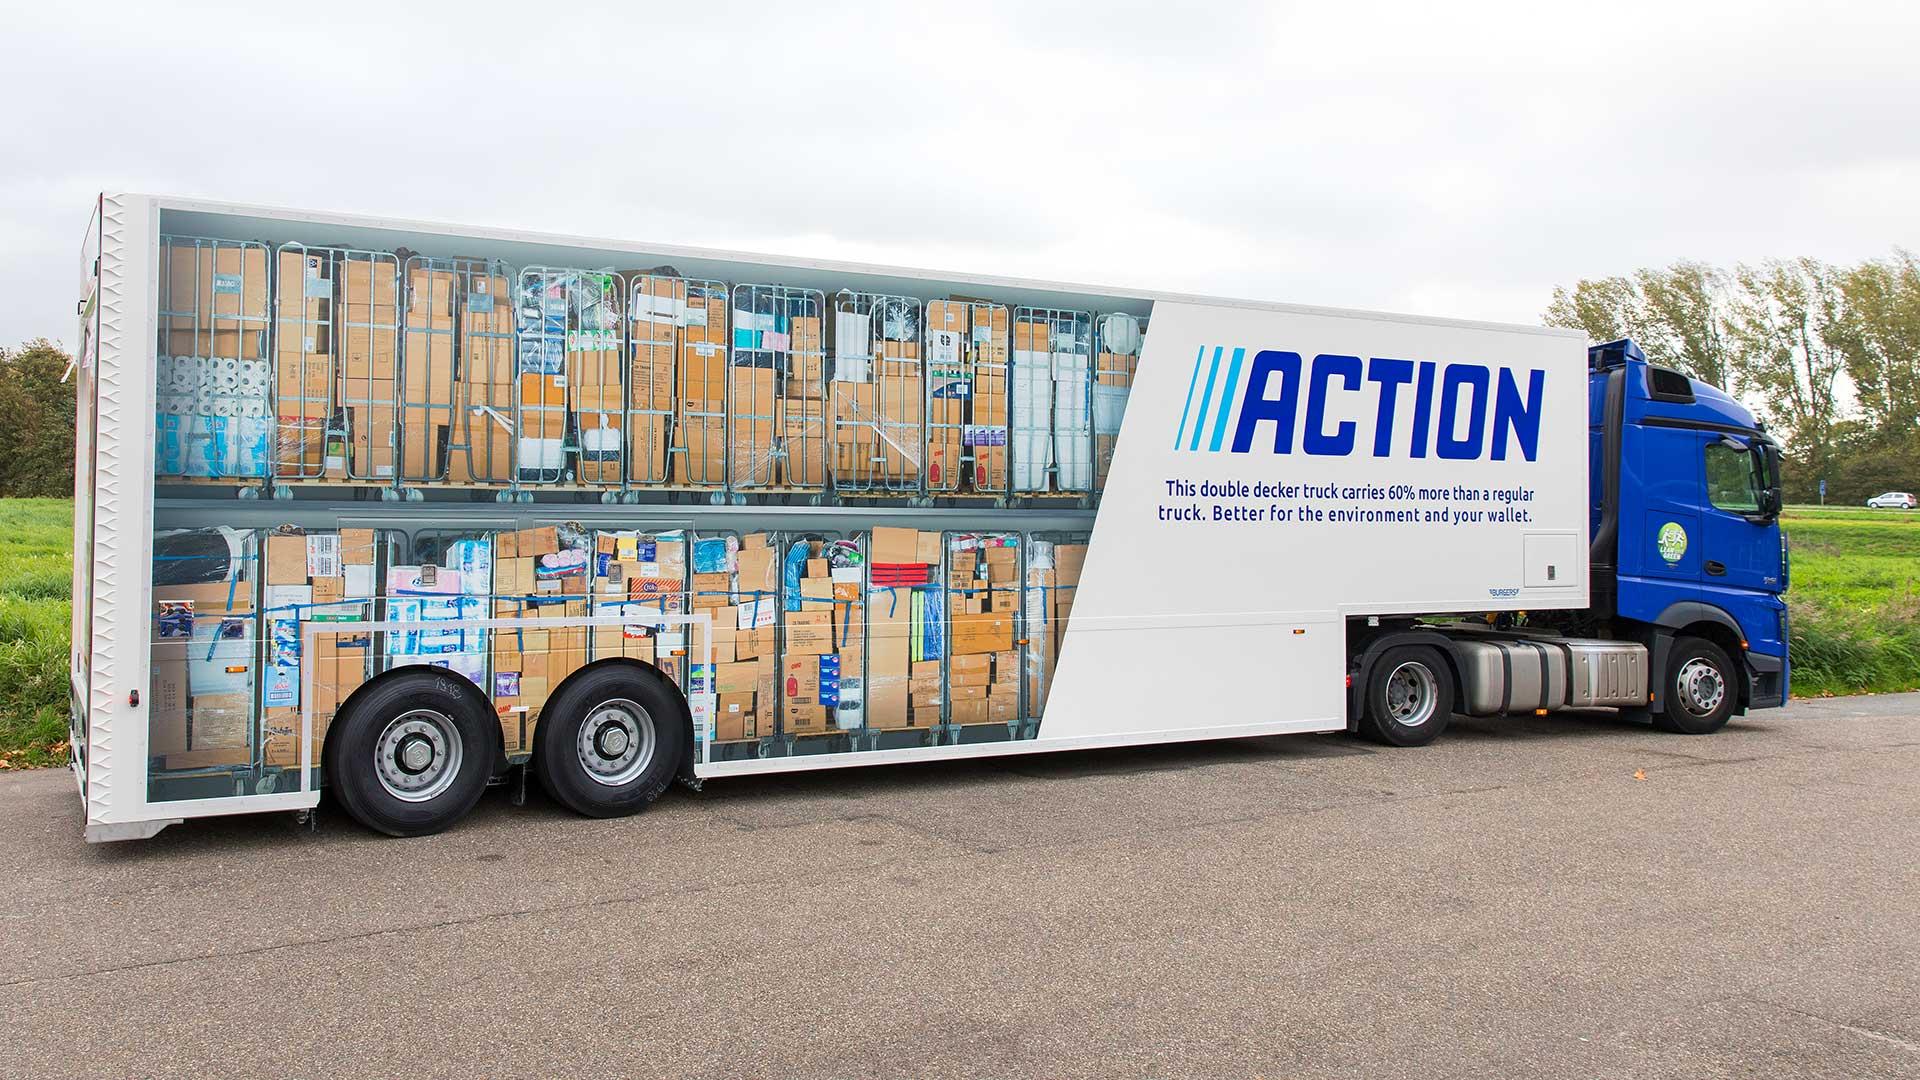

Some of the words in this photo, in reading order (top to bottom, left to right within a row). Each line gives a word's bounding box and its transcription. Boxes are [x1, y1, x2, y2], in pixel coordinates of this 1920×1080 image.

[1231, 350, 1545, 462] ACTION
[1165, 478, 1197, 497] This
[1200, 479, 1250, 498] double
[1253, 480, 1300, 499] decker
[1303, 482, 1339, 499] truck
[1341, 483, 1386, 500] carries
[1388, 484, 1416, 501] 60%
[1418, 488, 1450, 501] more
[1453, 484, 1480, 501] than
[1482, 489, 1490, 501] a
[1492, 485, 1535, 505] regular
[1158, 503, 1206, 521] truck.
[1213, 505, 1265, 522] Better
[1270, 504, 1294, 522] for
[1298, 504, 1323, 522] the
[1328, 505, 1420, 523] environment
[1424, 506, 1449, 523] and
[1453, 510, 1484, 526] your
[1487, 506, 1533, 523] wallet.
